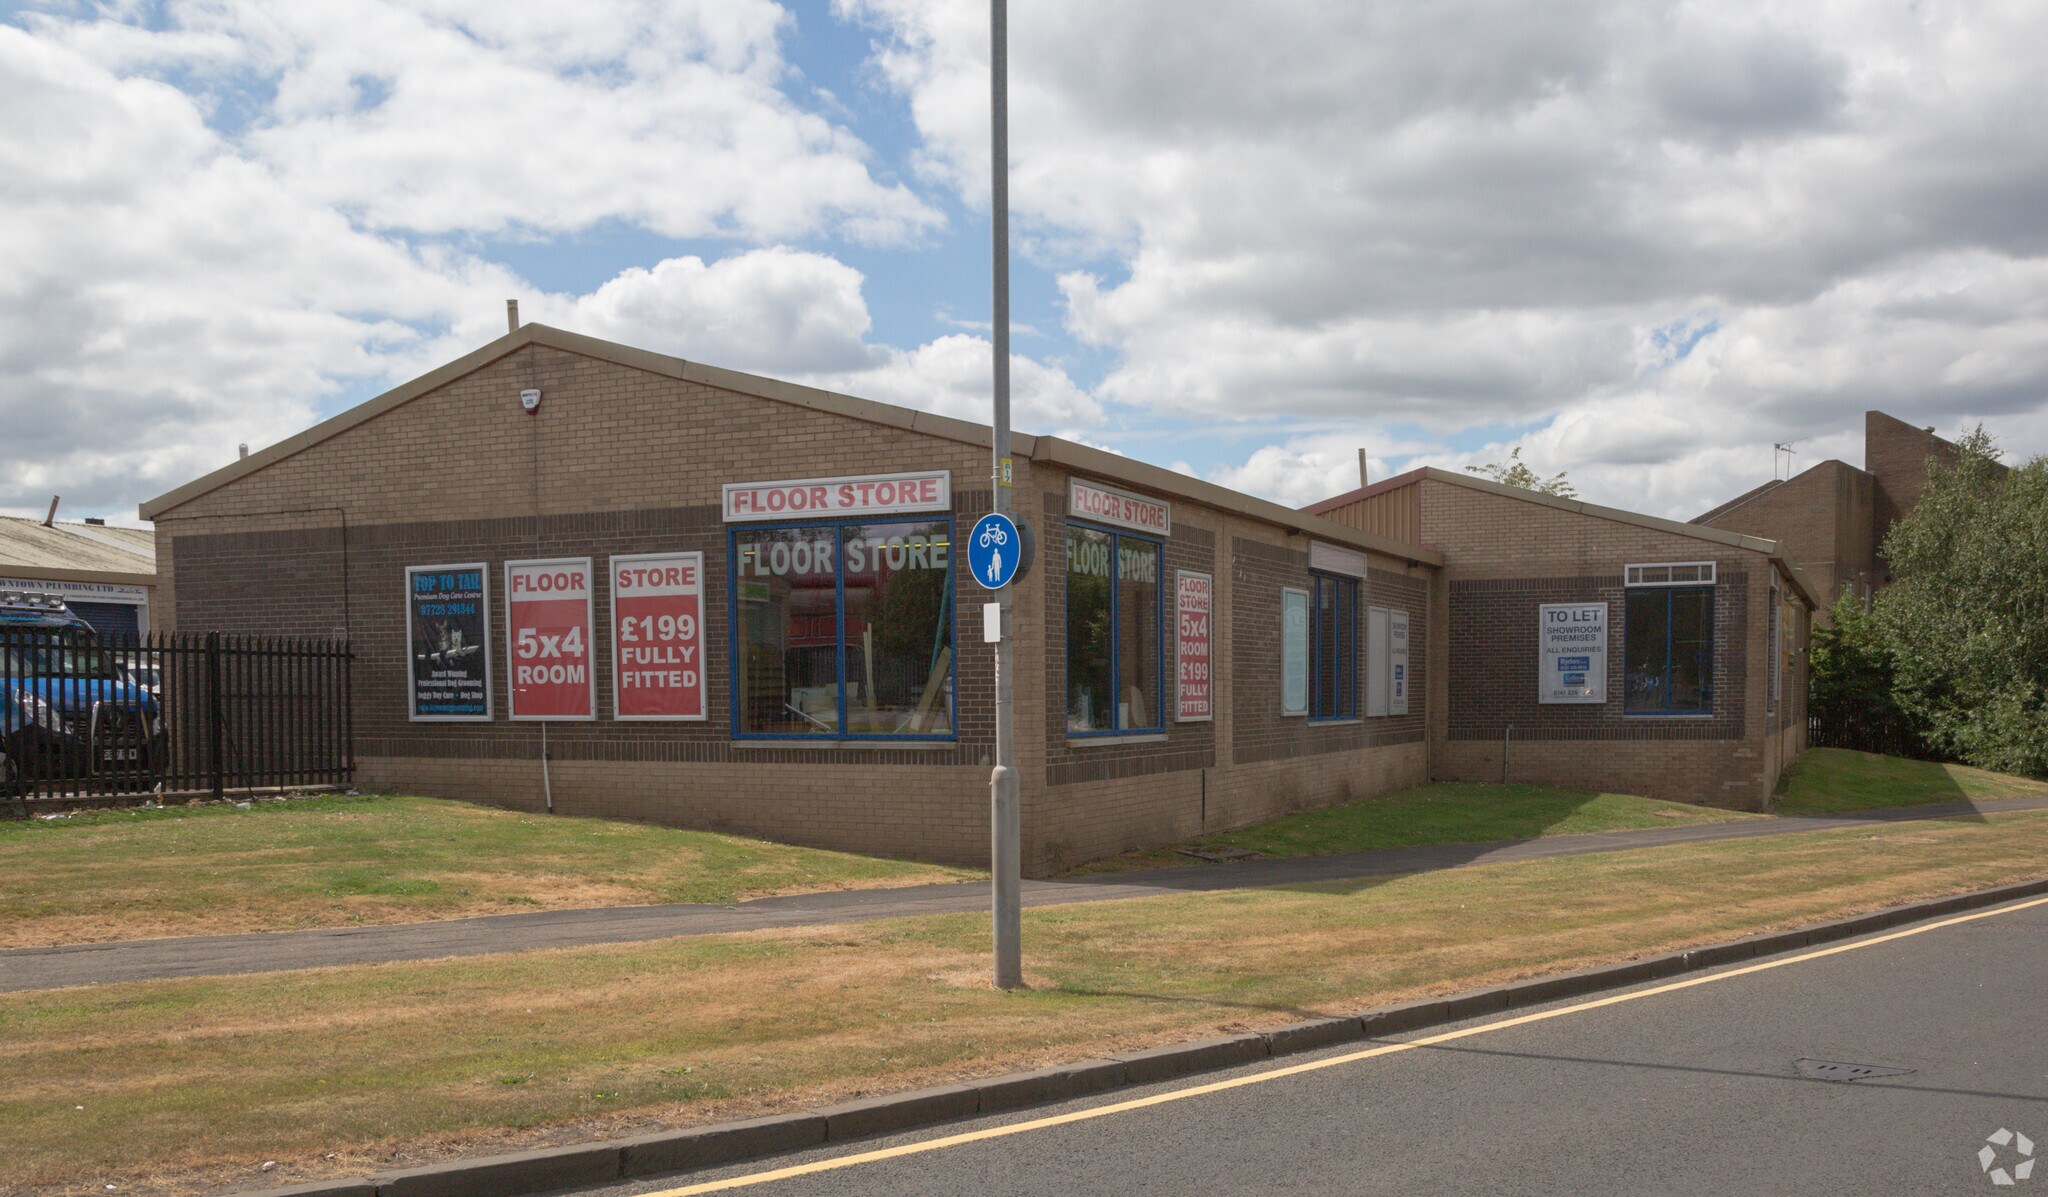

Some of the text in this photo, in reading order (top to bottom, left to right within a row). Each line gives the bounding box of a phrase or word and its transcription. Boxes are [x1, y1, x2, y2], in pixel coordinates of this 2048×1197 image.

[734, 479, 937, 514] FLOOR STORE
[1075, 486, 1164, 528] FLOOR STORE
[737, 534, 948, 577] FLOOR STORE
[1066, 538, 1155, 583] FLOOR STORE
[46, 582, 94, 591] PLUMBING
[414, 573, 481, 592] TOP TO TAIL
[513, 572, 585, 592] FLOOR
[618, 567, 696, 588] STORE
[1179, 577, 1208, 594] FLOOR
[447, 602, 475, 615] 291344
[1179, 595, 1208, 610] STORE
[1548, 610, 1600, 622] TO LET
[621, 614, 696, 642] £199
[1181, 614, 1207, 638] 5x4
[1547, 626, 1602, 634] SHOWROOM
[517, 626, 584, 659] 5x4
[1551, 634, 1596, 642] PREMISES
[621, 646, 695, 664] FULLY
[1181, 641, 1208, 657] ROOM
[517, 665, 585, 684] ROOM
[622, 670, 697, 688] FITTED
[1180, 662, 1208, 680] £199
[1180, 684, 1208, 696] FULLY
[1180, 700, 1208, 713] FITTED
